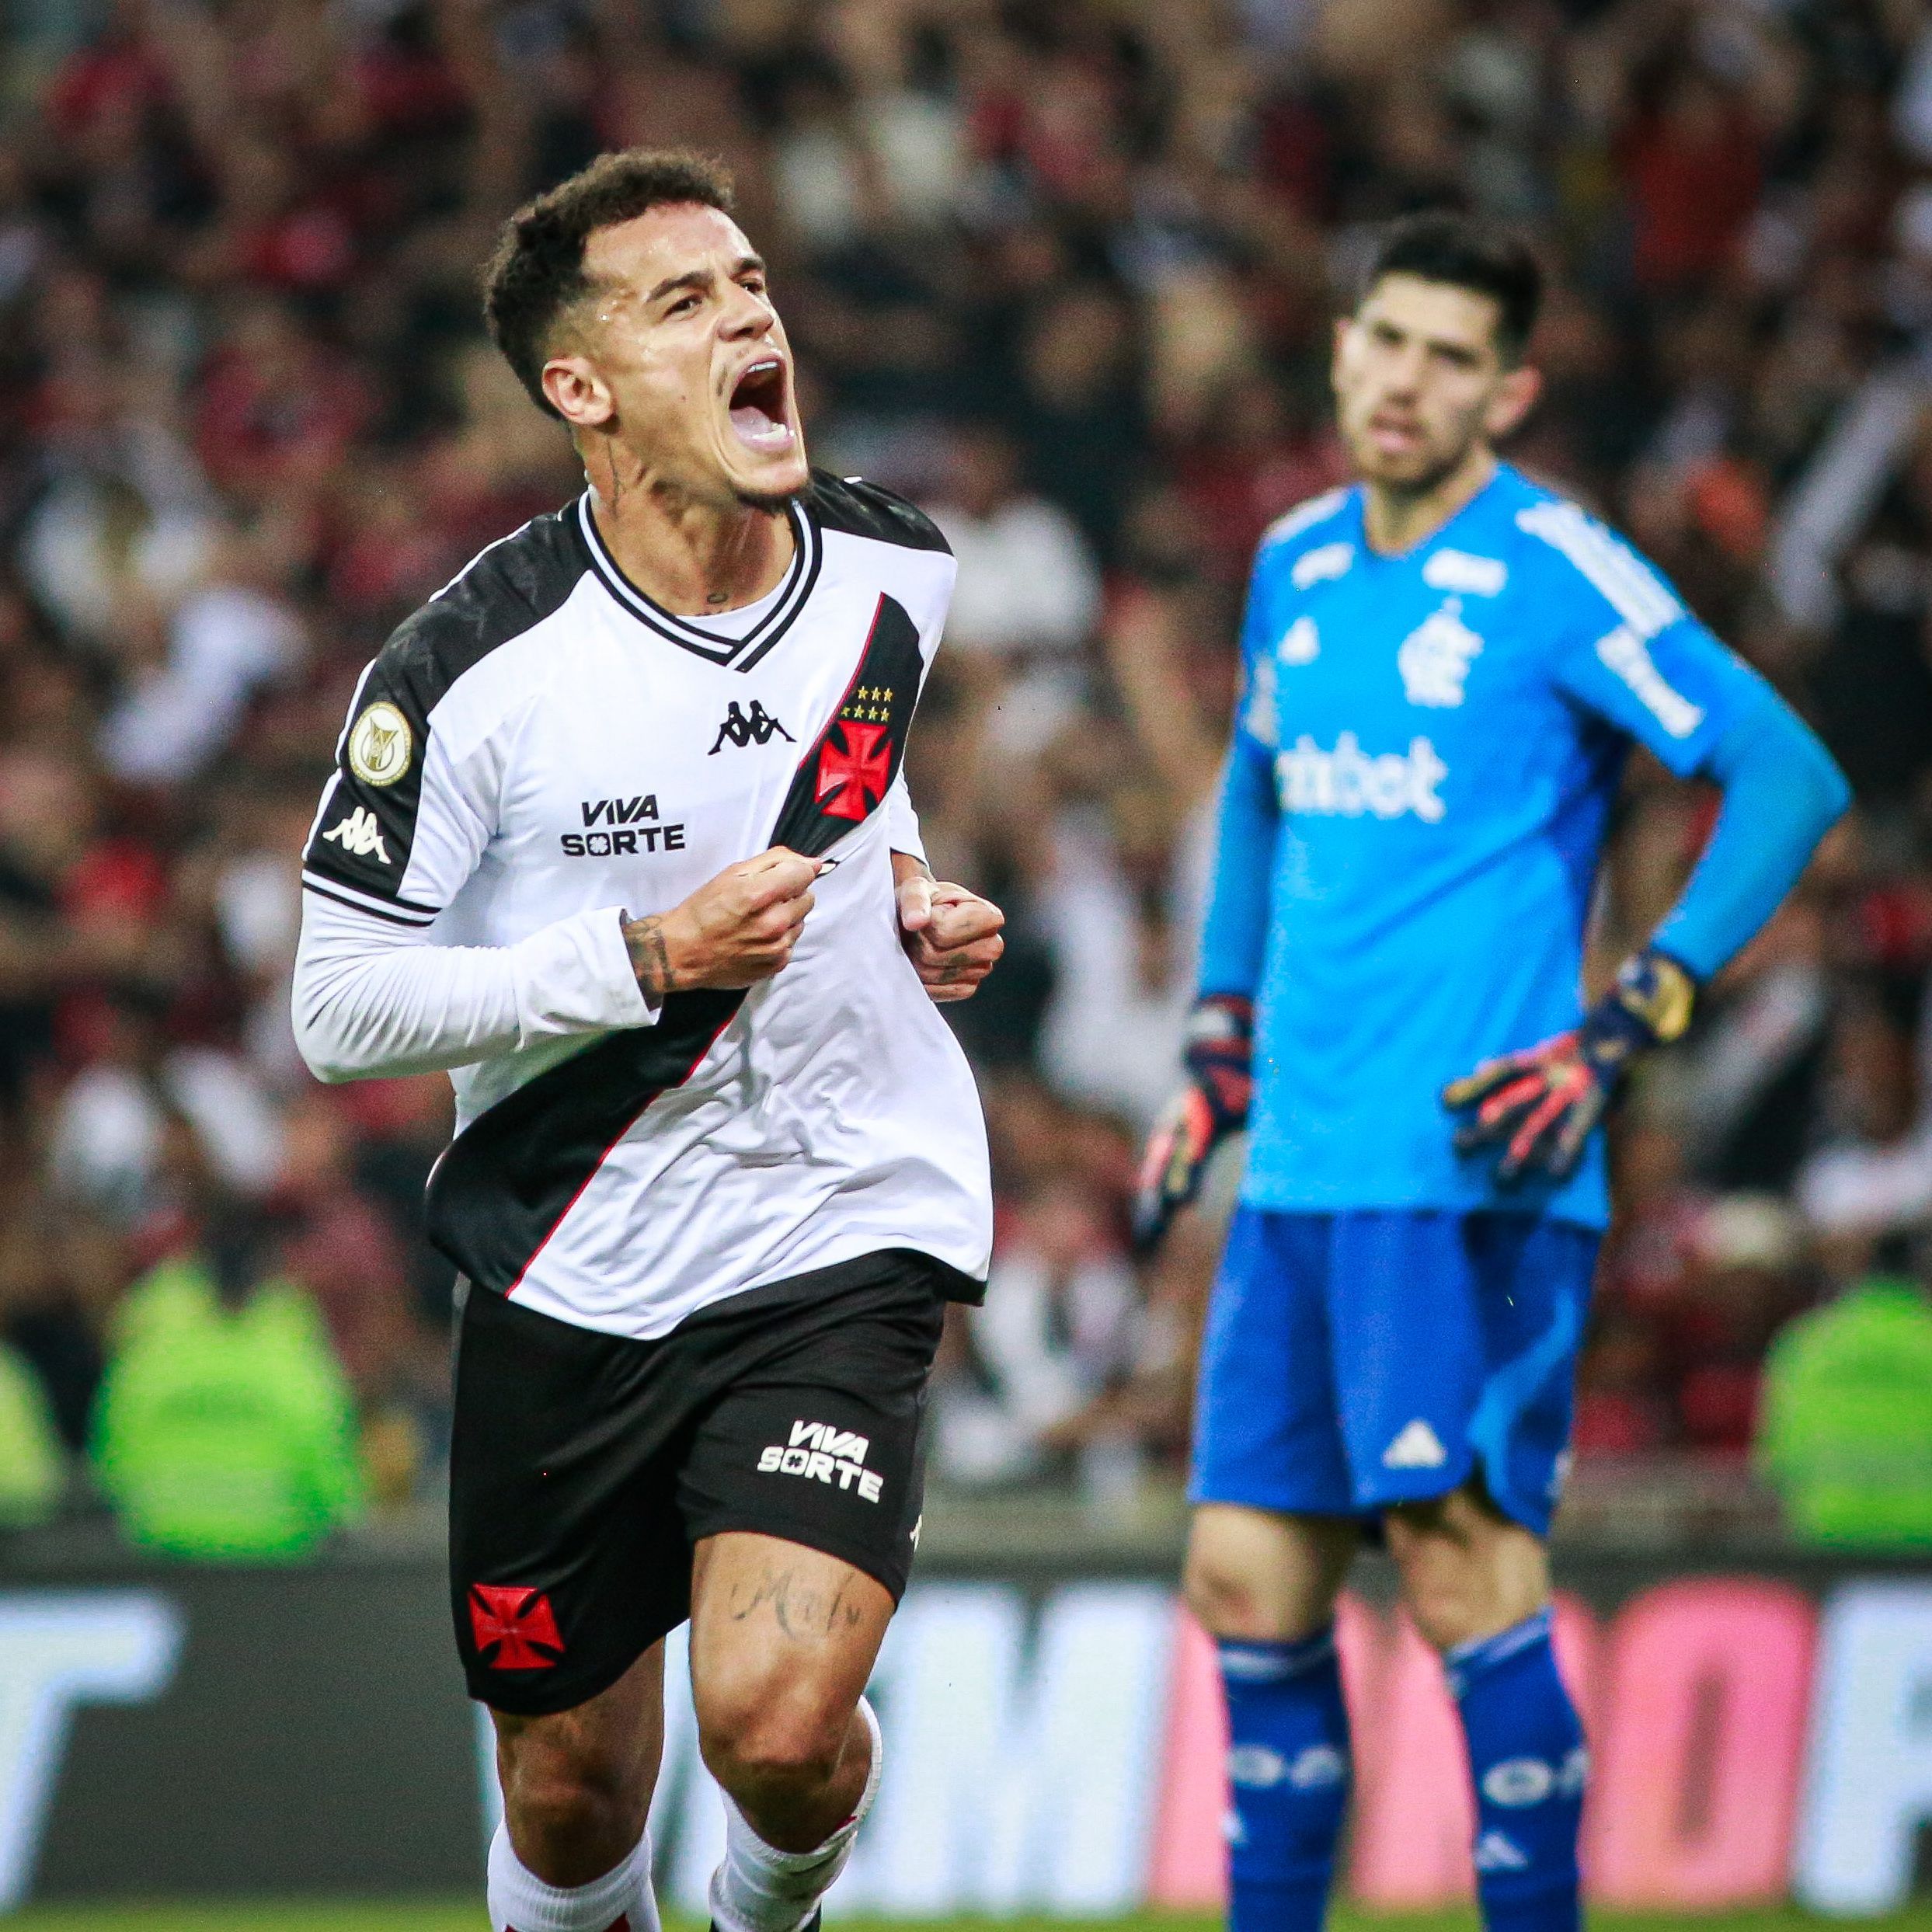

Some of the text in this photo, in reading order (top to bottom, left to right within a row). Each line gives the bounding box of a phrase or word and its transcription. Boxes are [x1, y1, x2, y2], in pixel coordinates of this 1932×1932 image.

[582, 794, 659, 827] VIVA
[560, 824, 685, 856] SORTE
[788, 1420, 869, 1465] VIVA
[757, 1446, 884, 1504] SORTE
